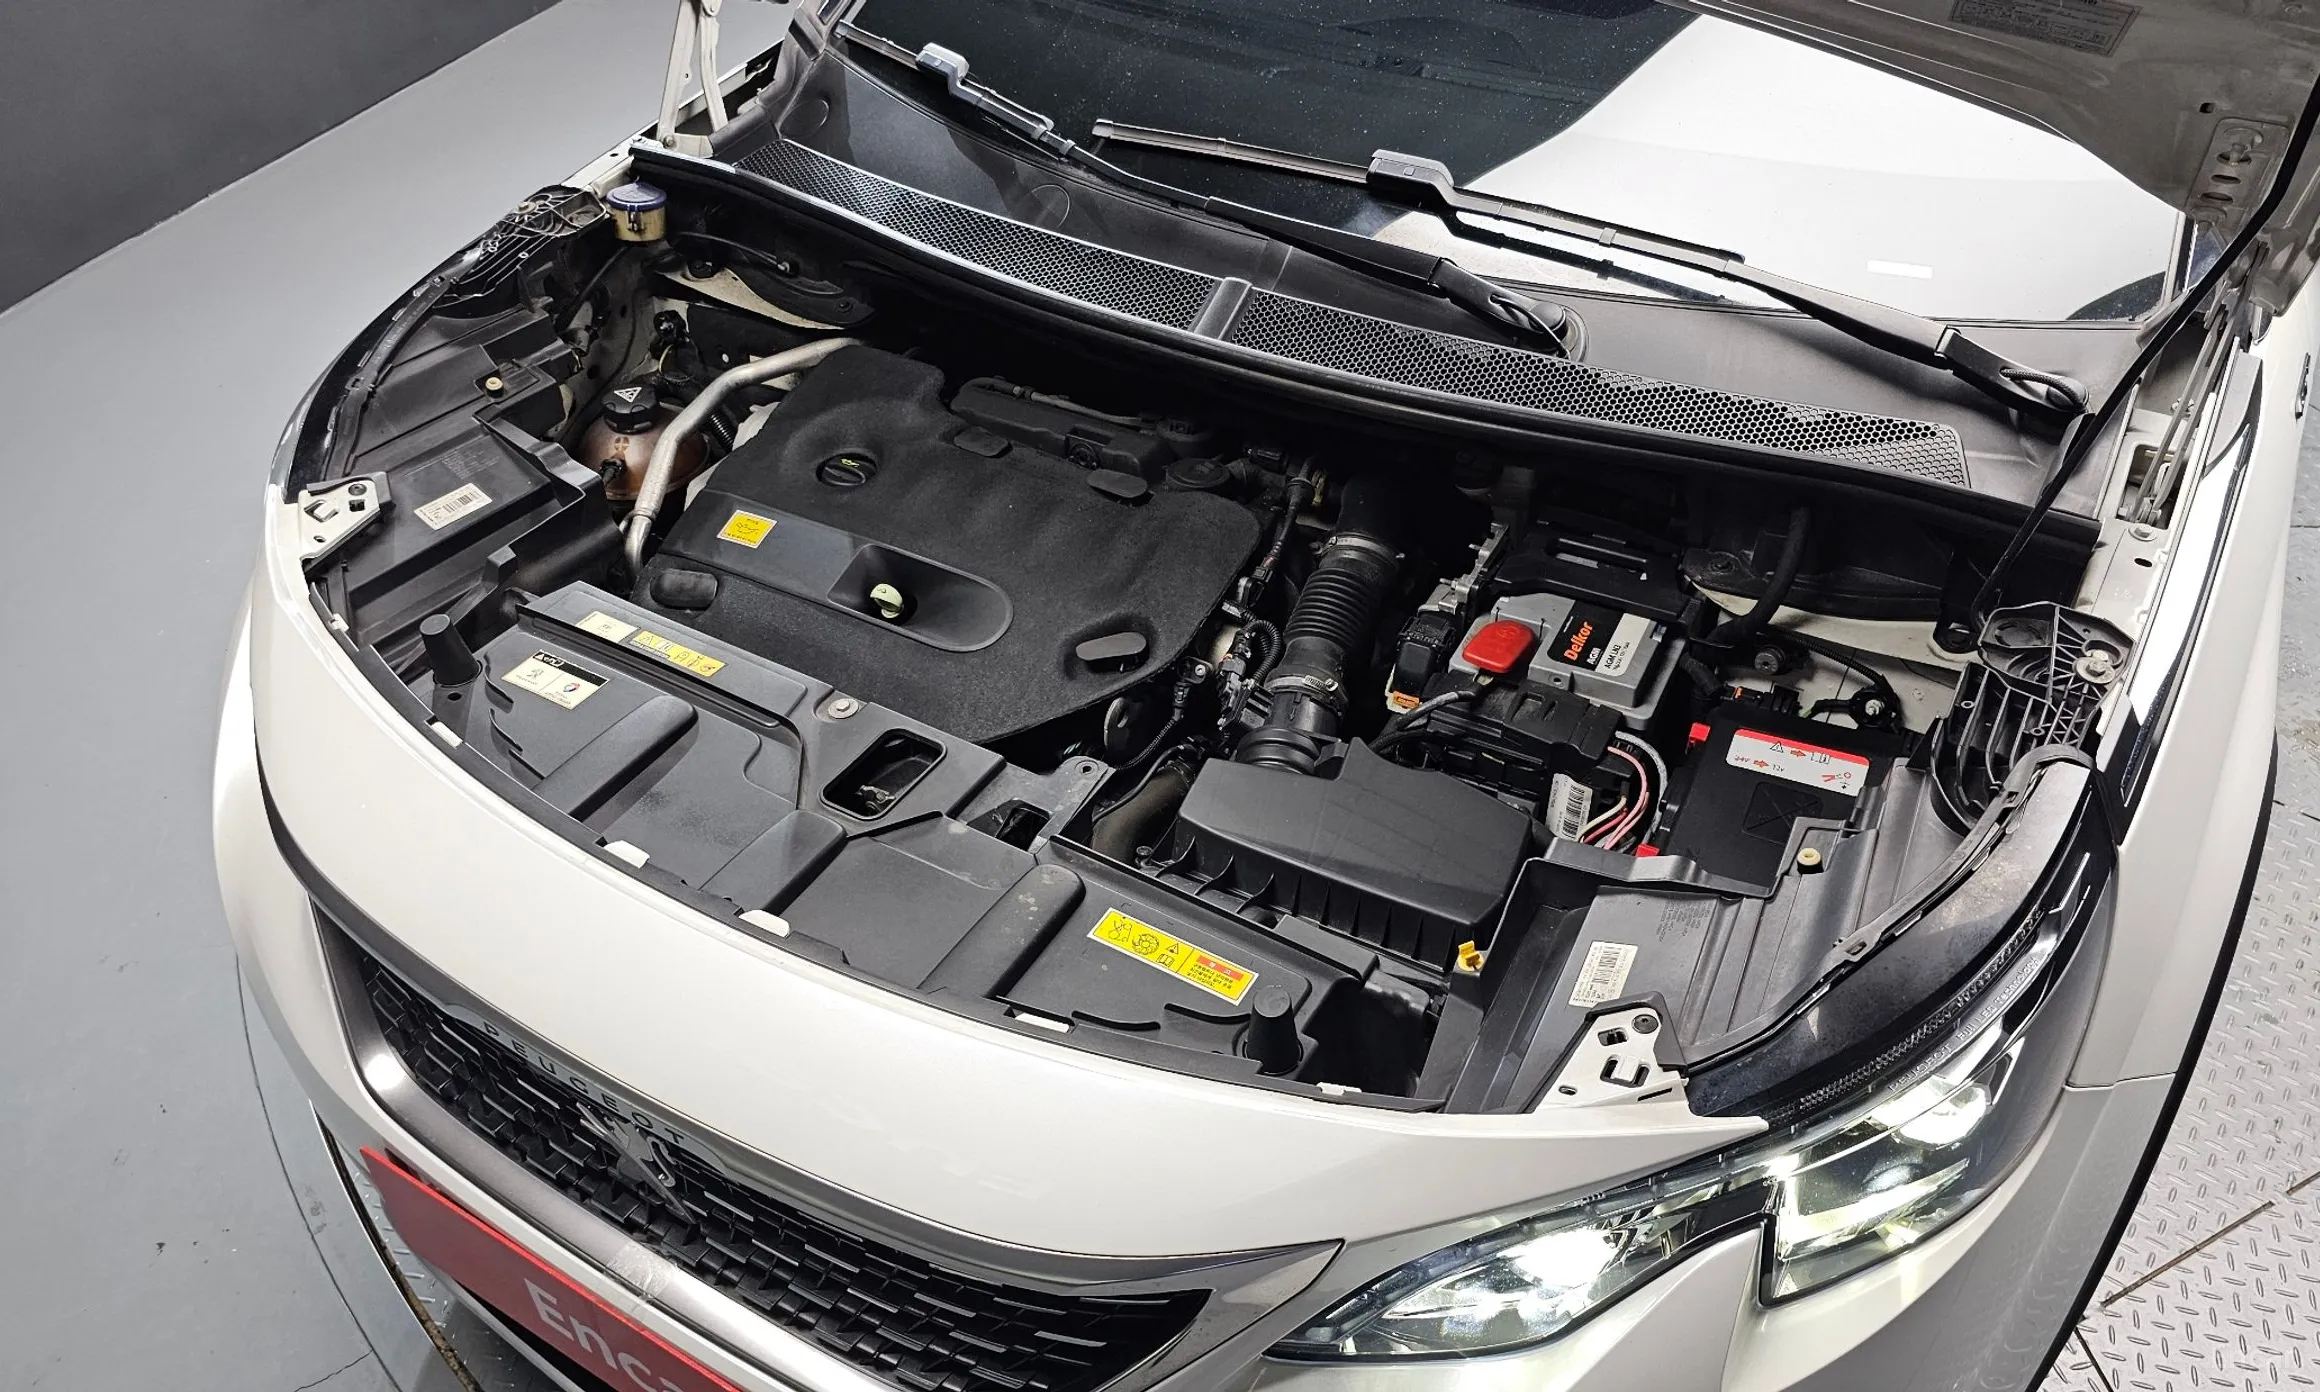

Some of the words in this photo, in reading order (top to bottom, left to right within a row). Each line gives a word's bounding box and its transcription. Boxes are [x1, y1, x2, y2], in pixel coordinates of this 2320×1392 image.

[1563, 621, 1593, 661] Delkor
[1586, 647, 1602, 665] AGM
[484, 1021, 685, 1145] PEUGEOT
[1888, 1043, 1951, 1092] PEUGEOT
[524, 1277, 684, 1392] Enc
